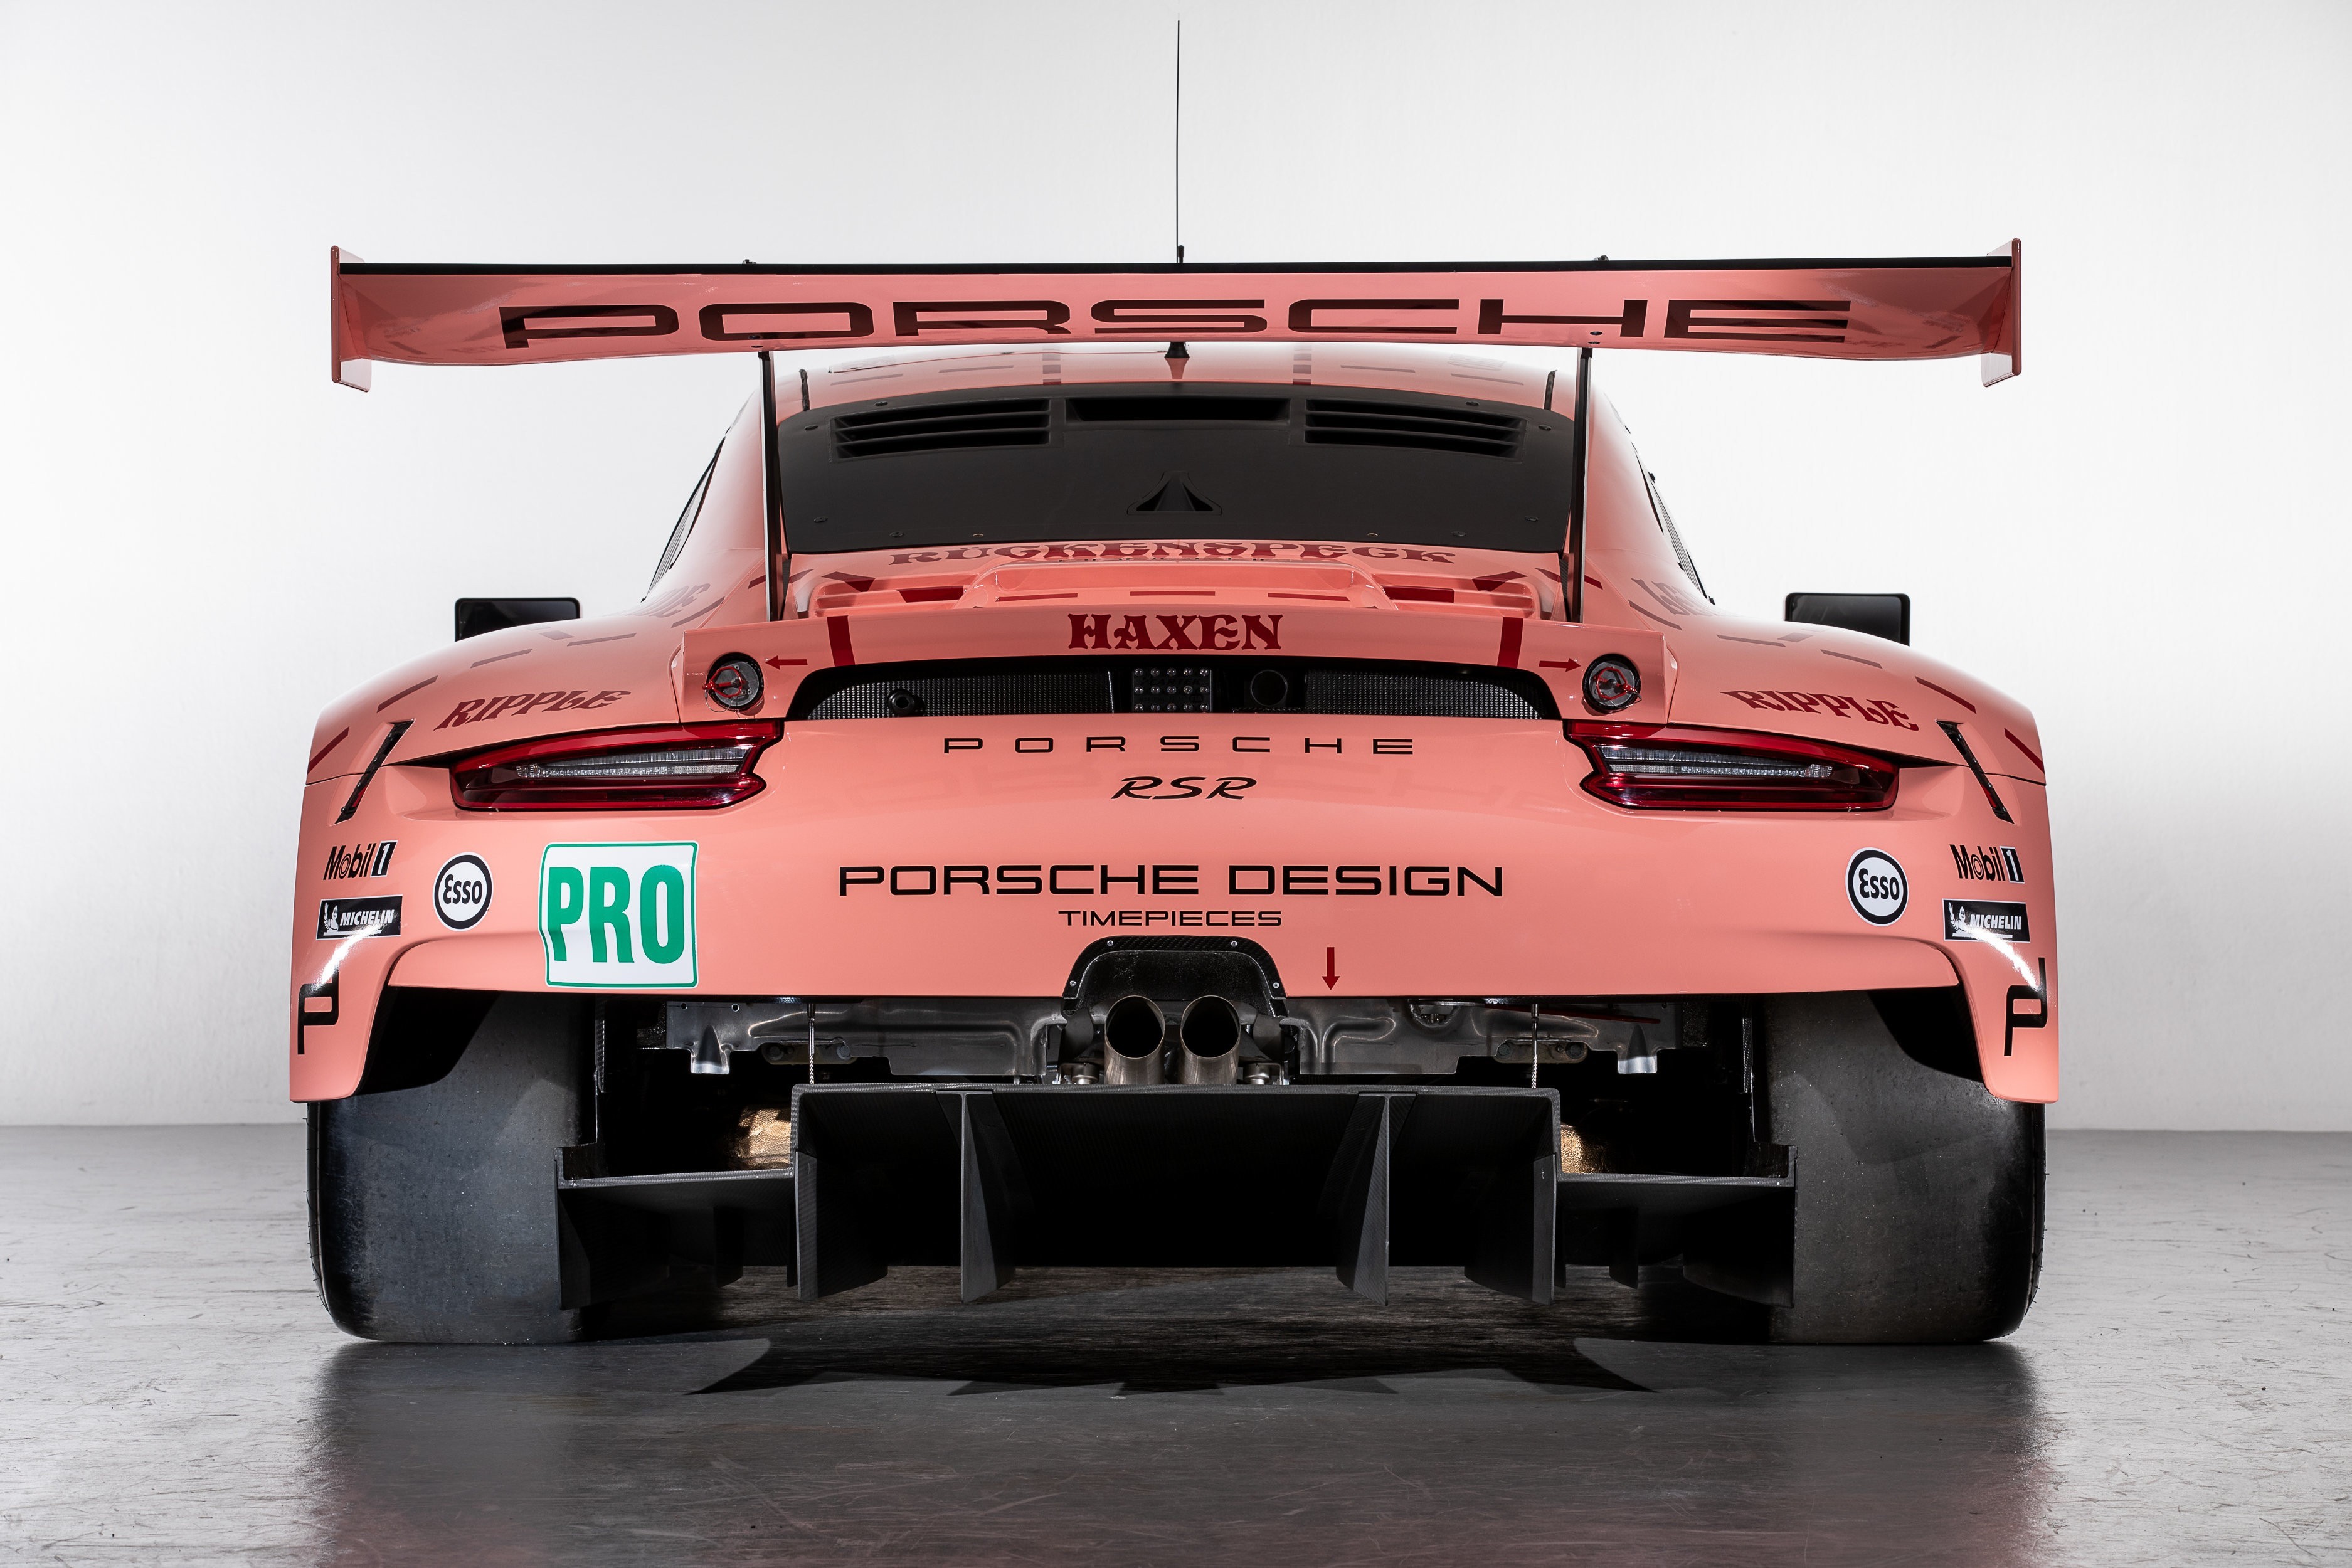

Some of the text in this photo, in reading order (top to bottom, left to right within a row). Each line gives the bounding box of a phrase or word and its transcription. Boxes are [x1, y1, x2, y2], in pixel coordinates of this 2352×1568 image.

[499, 298, 1851, 349] PORSCHE
[1068, 613, 1283, 650] HAXEN
[433, 690, 631, 731] RIPPLE
[1720, 691, 1919, 731] RIPPLE
[944, 736, 1412, 754] PORSCHE
[1111, 776, 1257, 800] RSR
[323, 843, 377, 880] Mobil
[1949, 844, 2006, 881] Mobil
[443, 874, 482, 904] Esso
[840, 865, 1502, 897] PORSCHE DESIGN
[1858, 868, 1899, 901] Esso
[339, 909, 395, 926] MICHELIN
[548, 867, 685, 964] PRO
[1058, 911, 1281, 926] TIMEPIECES
[1969, 914, 2021, 930] MICHELIN
